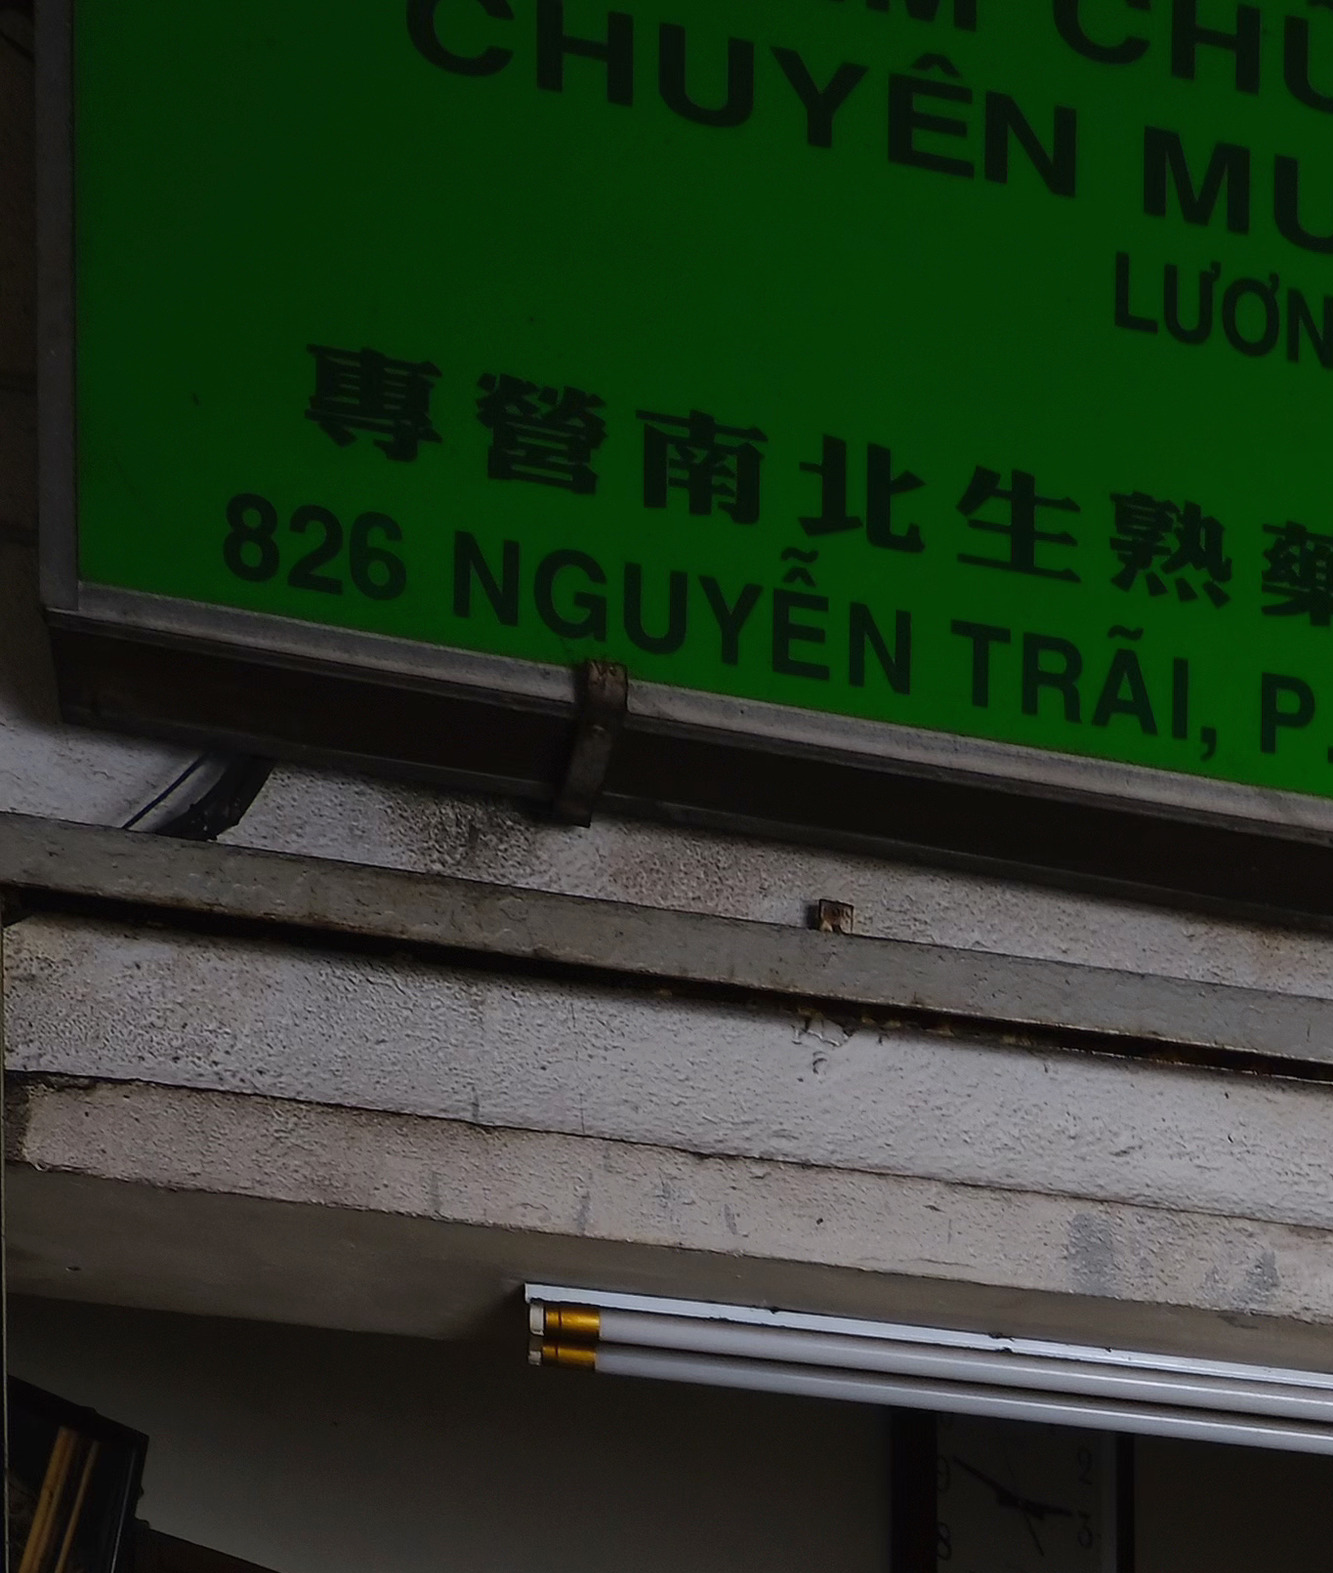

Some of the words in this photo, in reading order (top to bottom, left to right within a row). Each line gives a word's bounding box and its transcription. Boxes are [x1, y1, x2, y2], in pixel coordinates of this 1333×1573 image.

[402, 0, 1077, 198] CHUYÊN
[222, 492, 407, 600] 826
[452, 546, 912, 698] NGUYỄN
[950, 618, 1218, 762] TRÃI,
